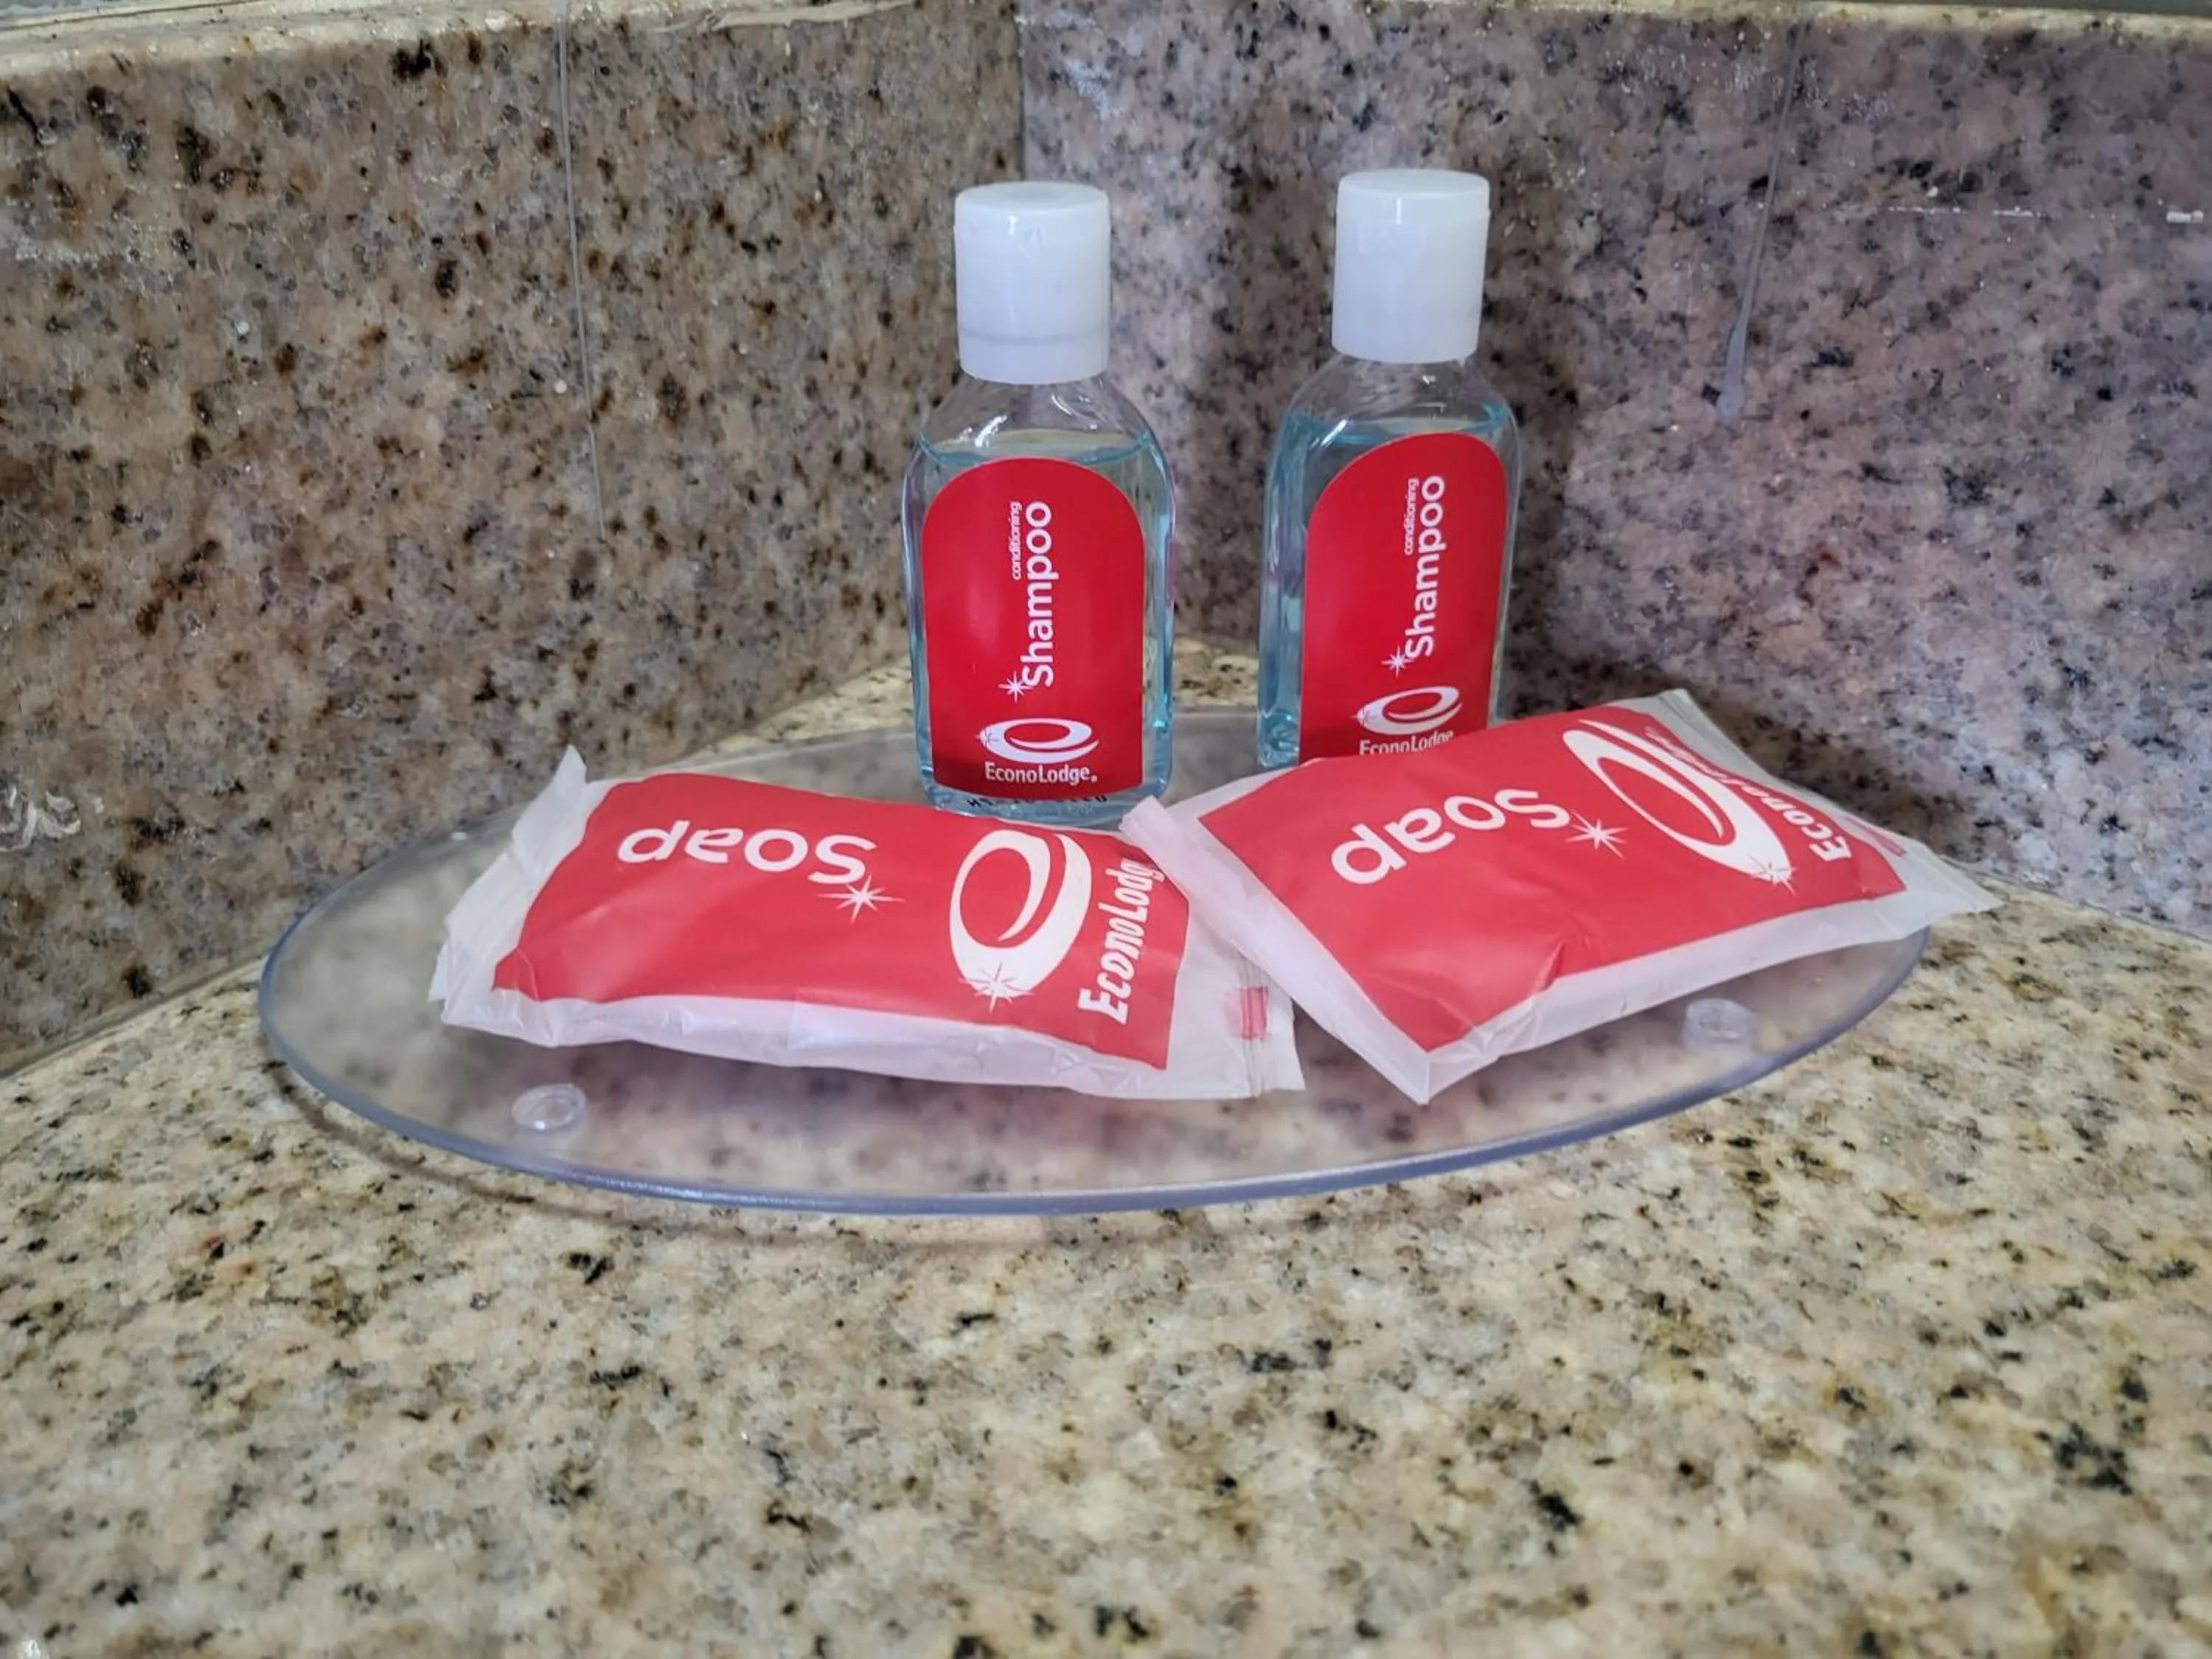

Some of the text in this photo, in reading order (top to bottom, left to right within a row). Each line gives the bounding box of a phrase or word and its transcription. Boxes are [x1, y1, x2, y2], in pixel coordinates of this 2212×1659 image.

[1009, 501, 1023, 581] conditioning
[1403, 478, 1419, 555] conditioning
[1020, 501, 1060, 687] Shampoo
[1405, 476, 1447, 658] Shampoo
[617, 819, 877, 885] Soap
[1330, 788, 1571, 885] Soap
[1077, 856, 1166, 1025] EconoLodg
